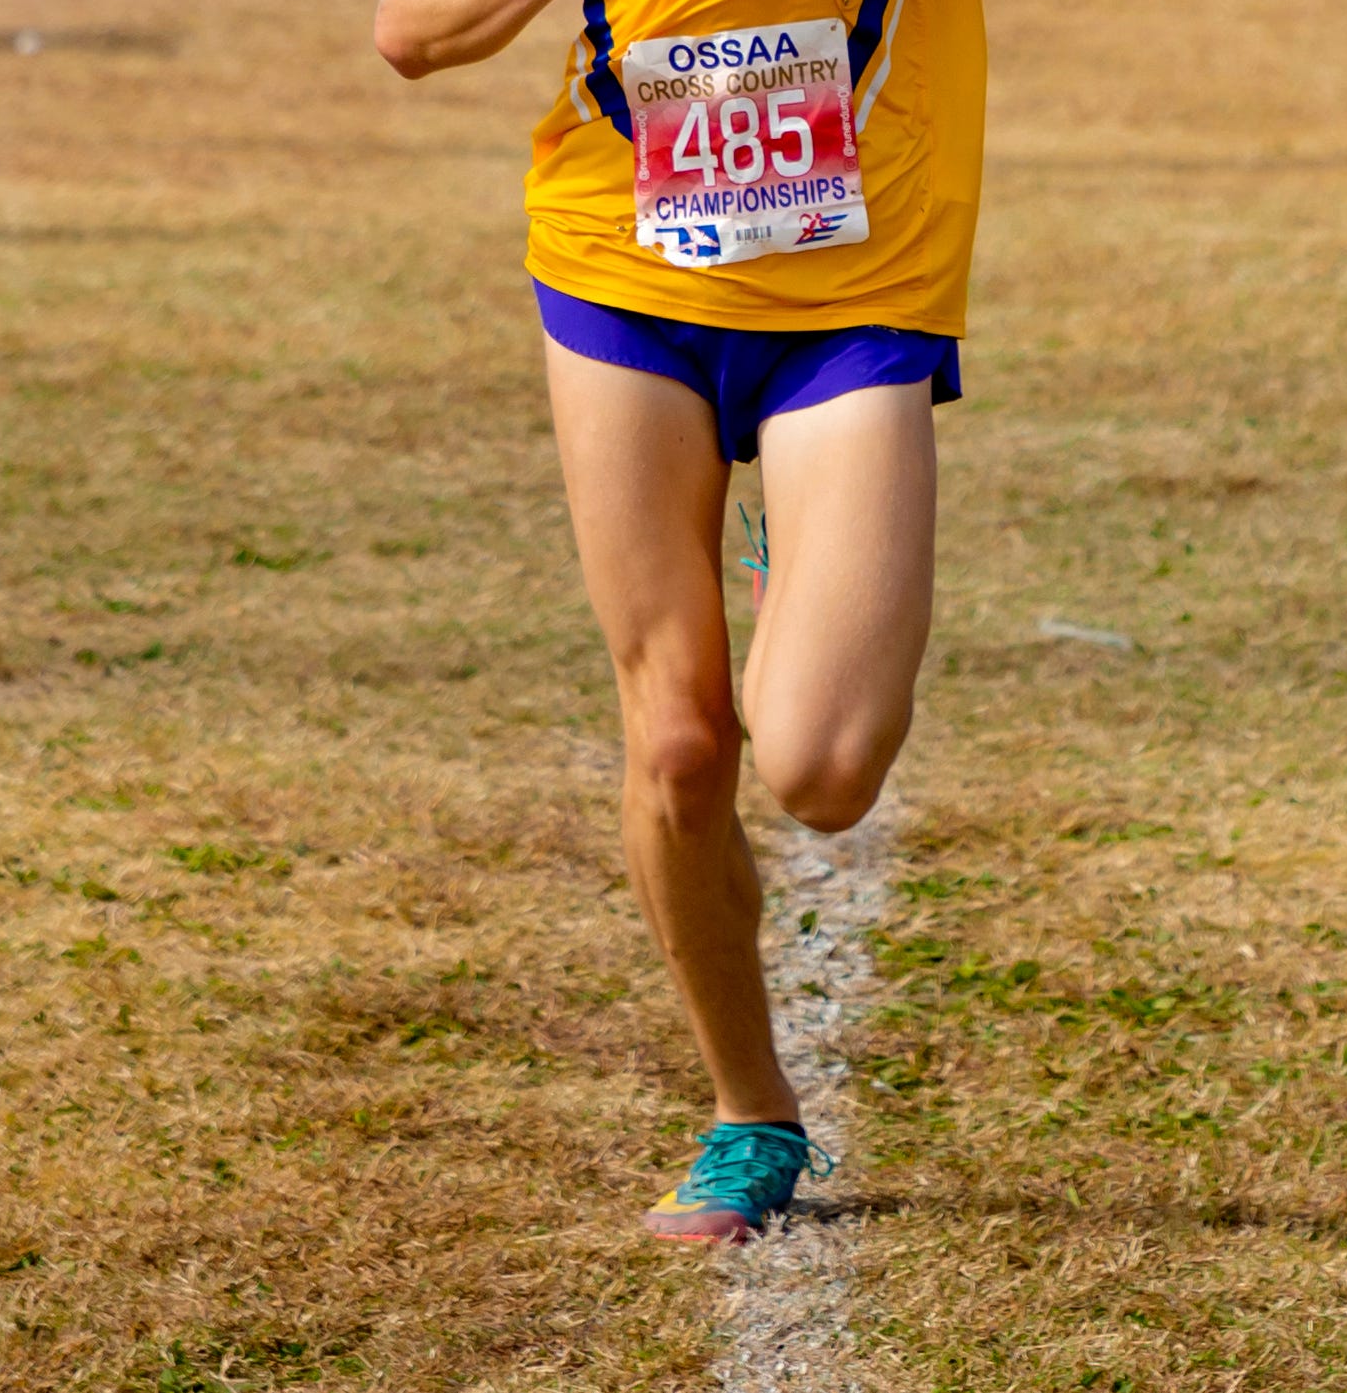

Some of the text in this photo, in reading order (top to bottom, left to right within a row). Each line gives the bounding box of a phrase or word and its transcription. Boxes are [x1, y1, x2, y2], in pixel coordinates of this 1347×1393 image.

[668, 32, 800, 73] OSSAA
[637, 57, 839, 104] CROSS COUNTRY
[671, 88, 815, 188] 485
[655, 175, 847, 221] CHAMPIONSHIPS
